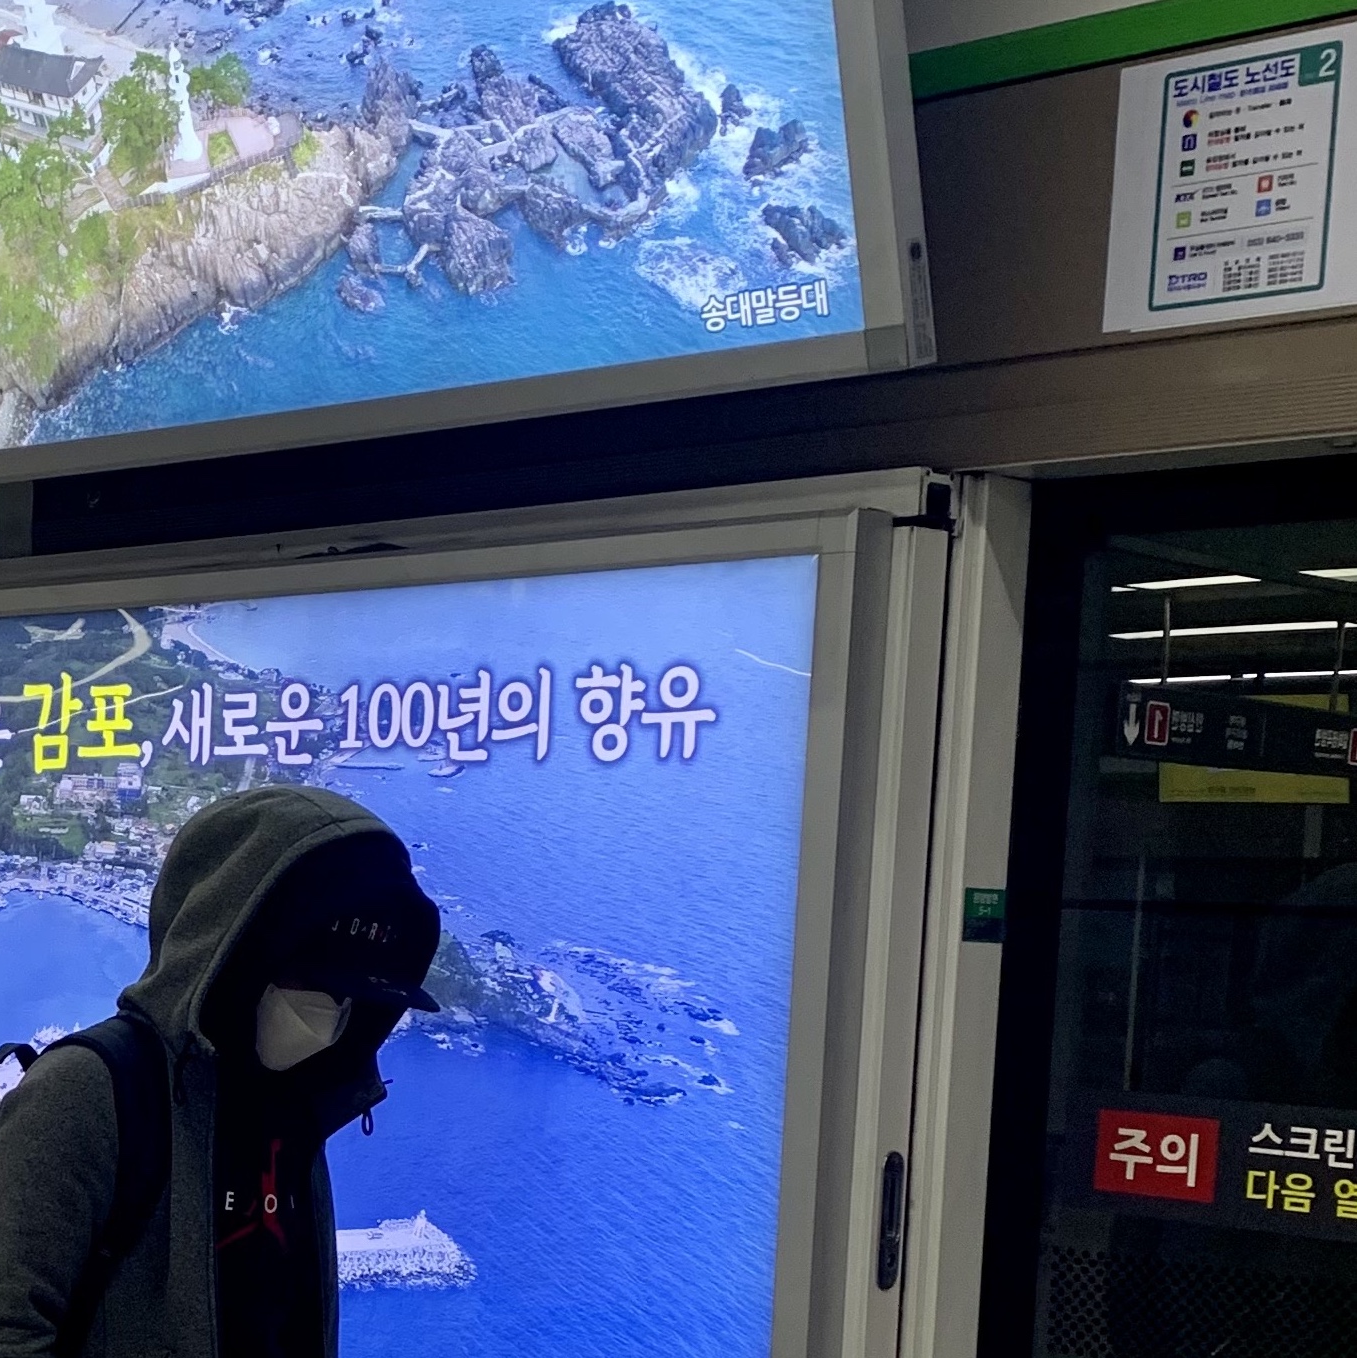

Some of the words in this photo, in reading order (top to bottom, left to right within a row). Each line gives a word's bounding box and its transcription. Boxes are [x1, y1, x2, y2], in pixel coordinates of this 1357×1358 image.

[1244, 58, 1296, 85] 노선도
[1319, 48, 1337, 77] 2
[701, 279, 829, 332] 송대말등대
[162, 682, 324, 766] 새로운
[339, 667, 550, 762] 100년의
[576, 663, 717, 763] 향유
[1109, 1127, 1199, 1188] 주의
[1248, 1122, 1356, 1170] 스크린
[1246, 1170, 1316, 1213] 다음
